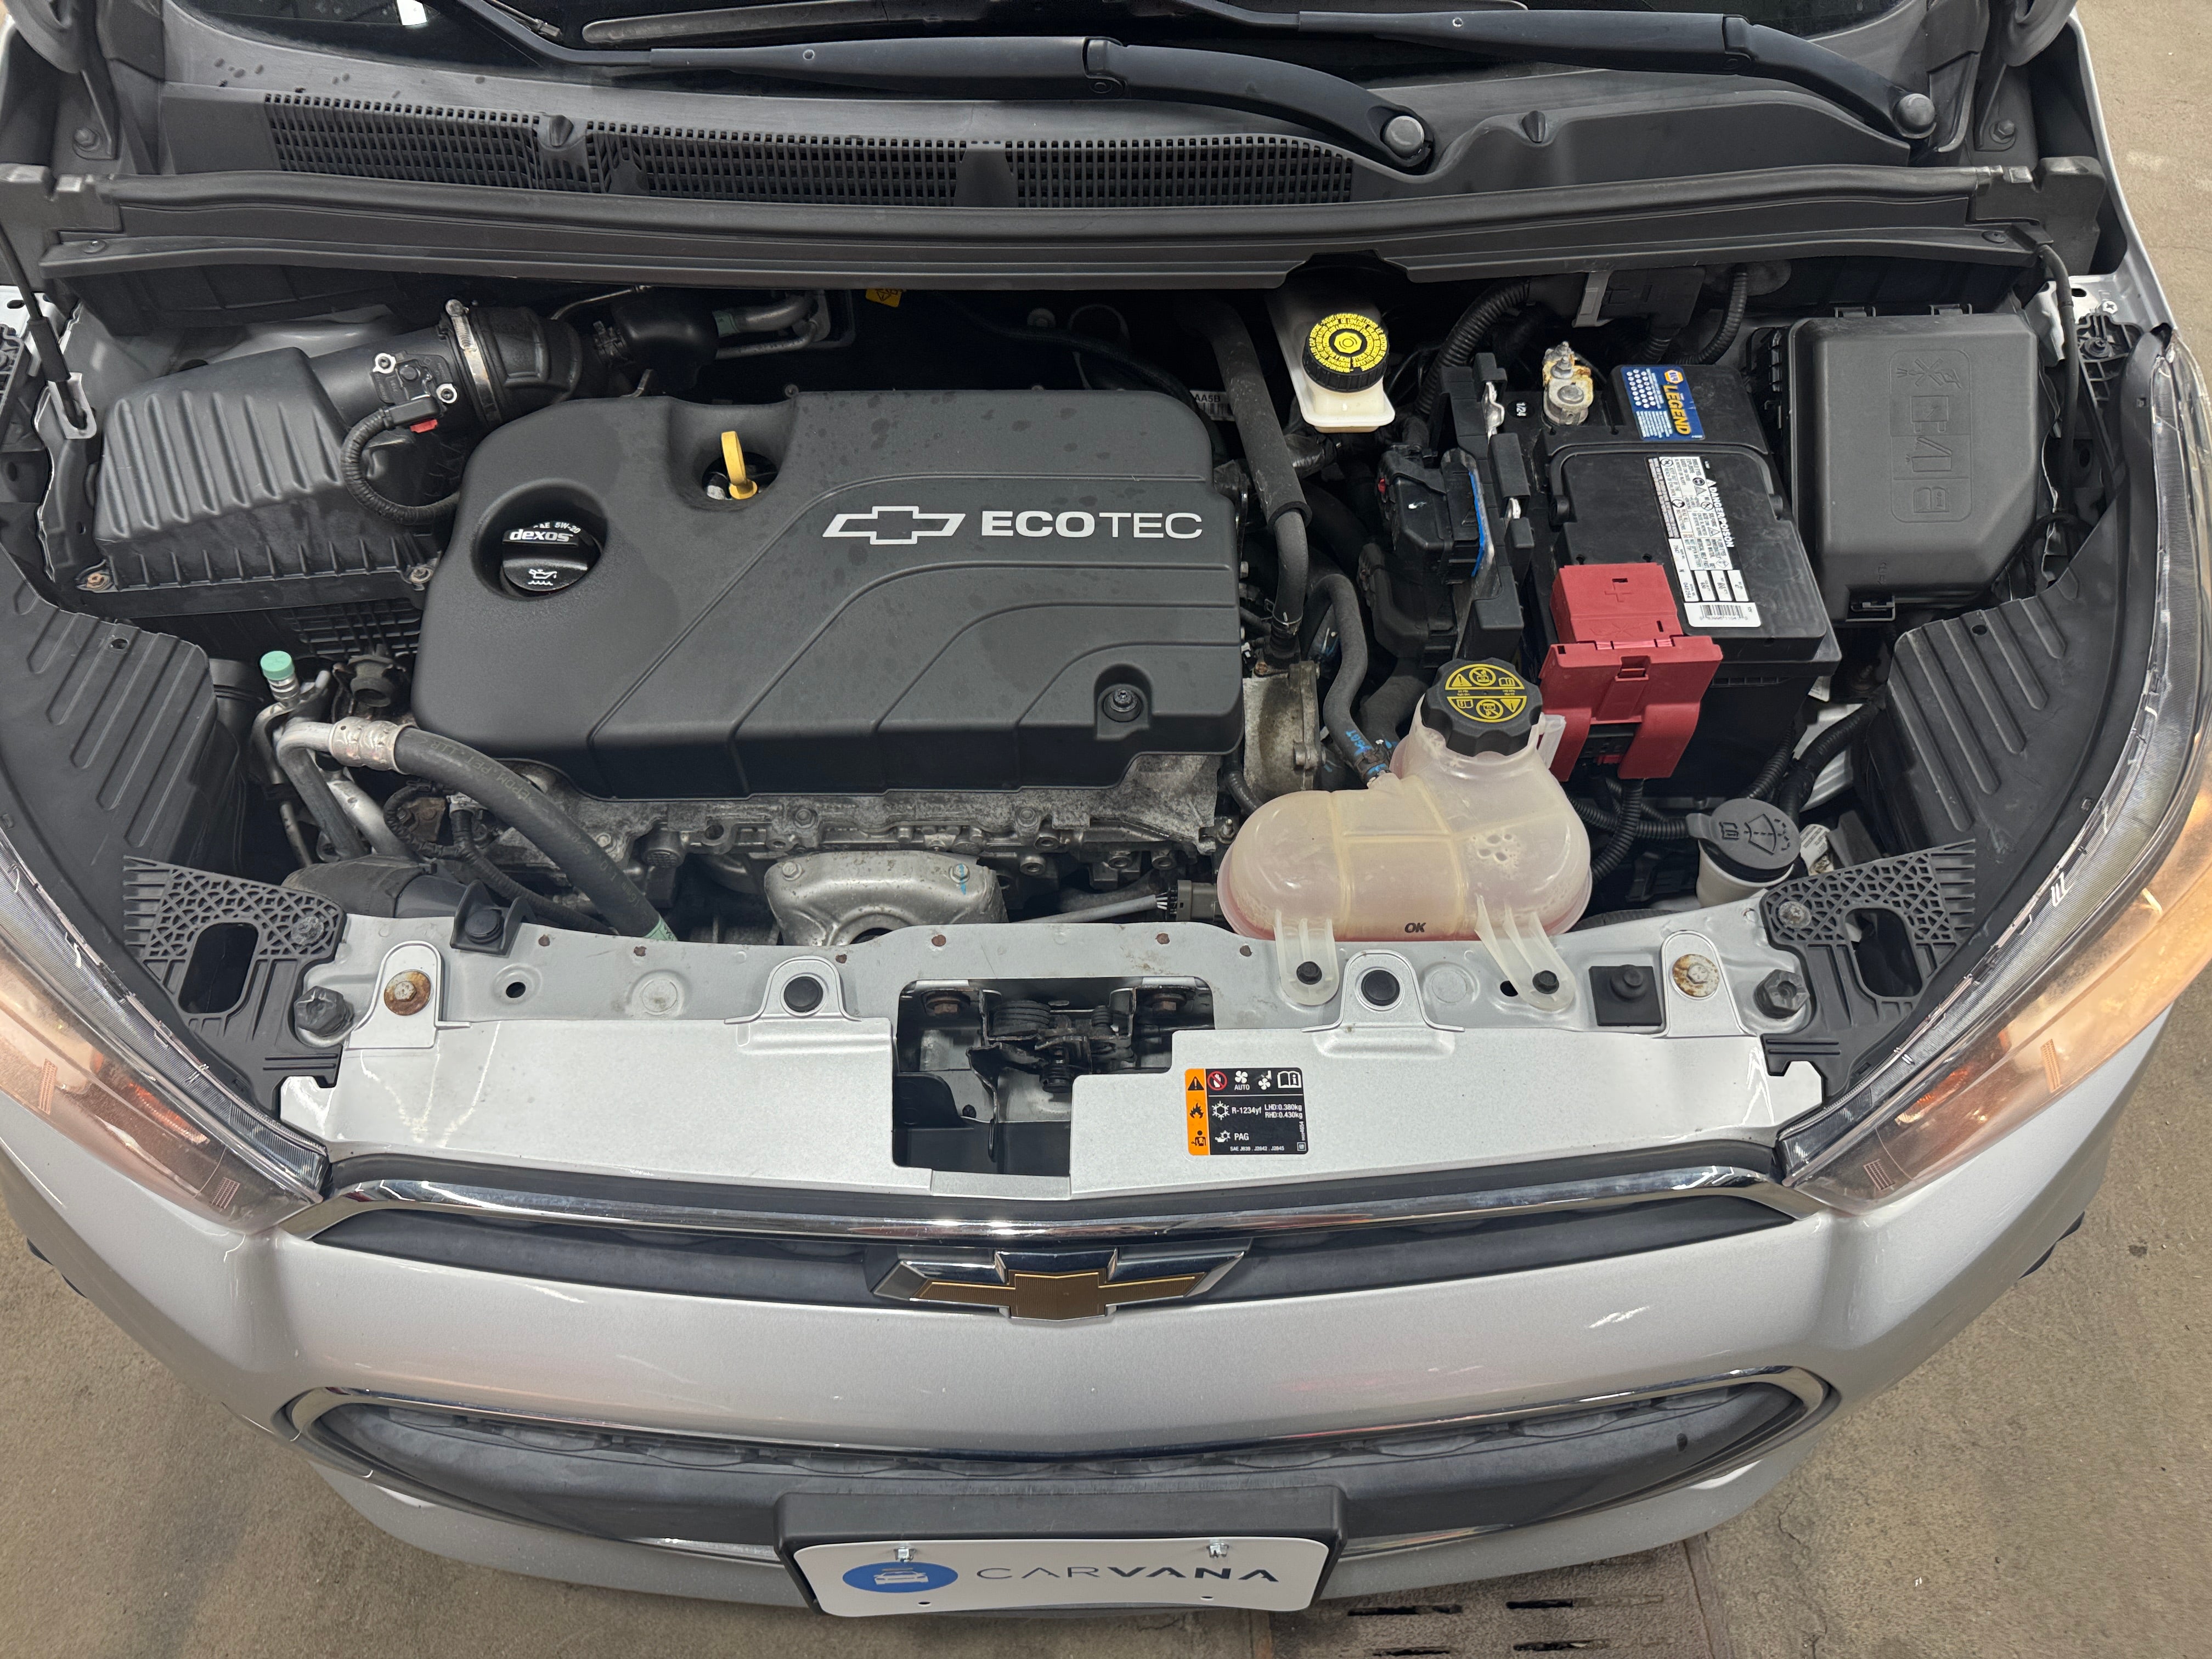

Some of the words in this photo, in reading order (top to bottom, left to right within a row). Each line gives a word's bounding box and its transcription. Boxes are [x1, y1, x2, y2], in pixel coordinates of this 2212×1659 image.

[1516, 402, 1526, 416] 1/24
[1663, 385, 1691, 435] LEGEND
[1709, 487, 1735, 548] DANGER/POISON
[555, 522, 581, 534] 5W-20
[981, 511, 1203, 539] ECOTEC
[510, 529, 573, 542] dexos
[1404, 922, 1426, 933] OK
[1232, 1107, 1262, 1115] R-1234yf
[977, 1566, 1279, 1582] CARVANA
